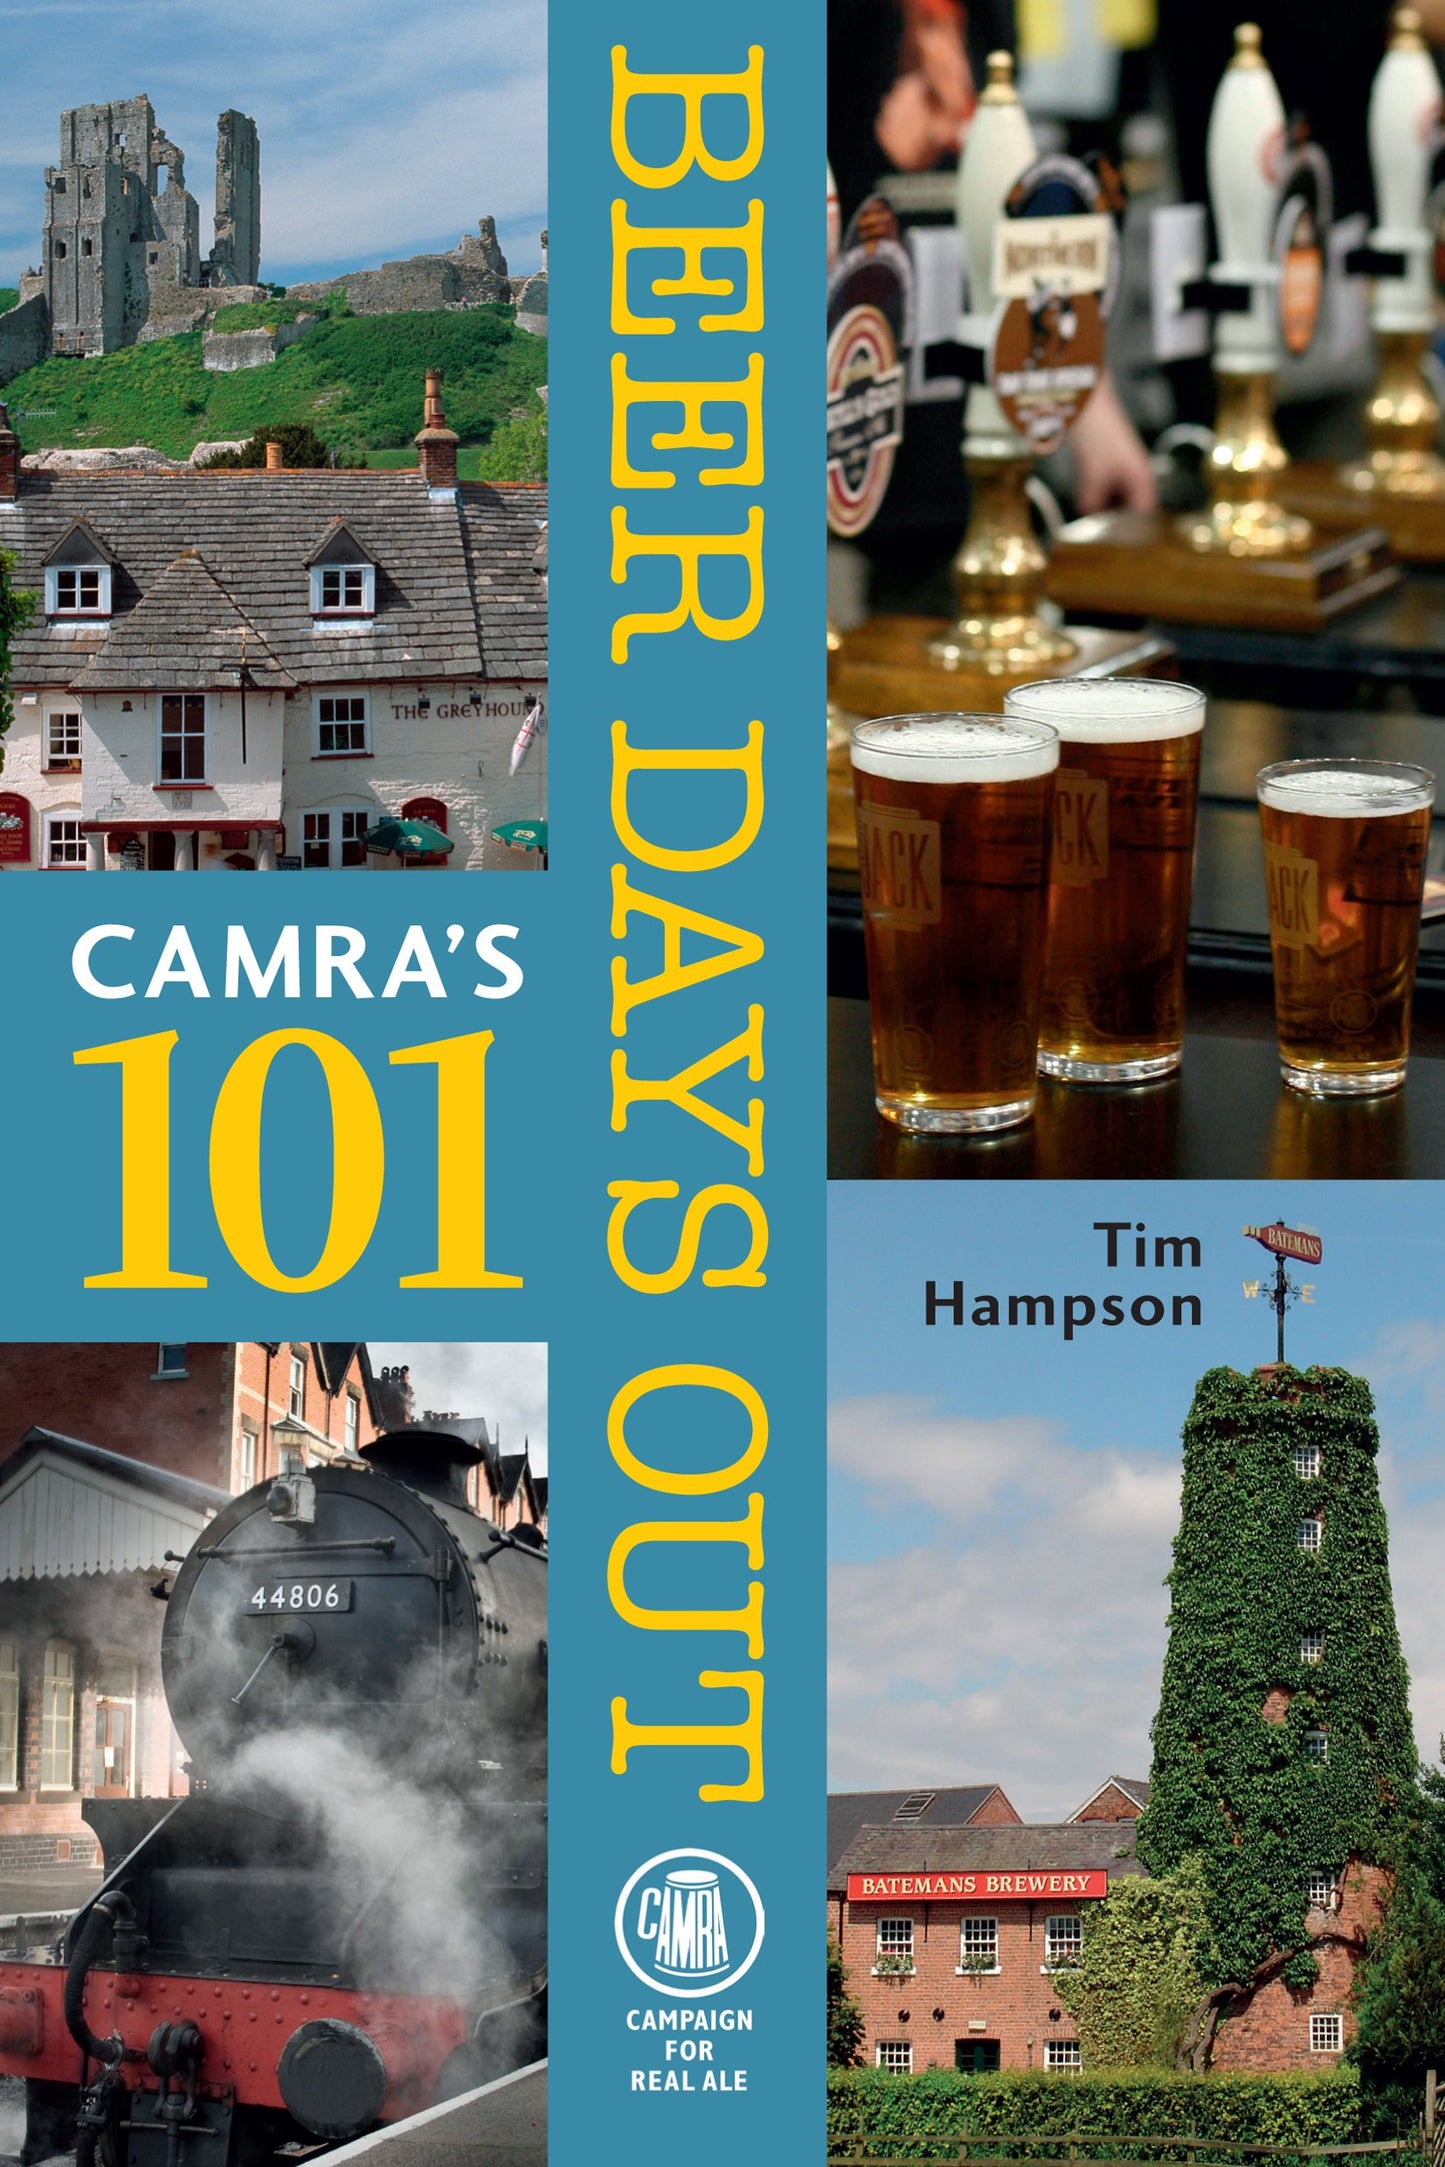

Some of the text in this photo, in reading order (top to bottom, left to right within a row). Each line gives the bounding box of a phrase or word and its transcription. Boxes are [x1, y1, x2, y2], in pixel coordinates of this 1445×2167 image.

[391, 704, 428, 720] THE
[1268, 1228, 1321, 1258] BATEMANS
[251, 1584, 339, 1610] 44806
[862, 1875, 1091, 1895] BATEMANS BREWERY
